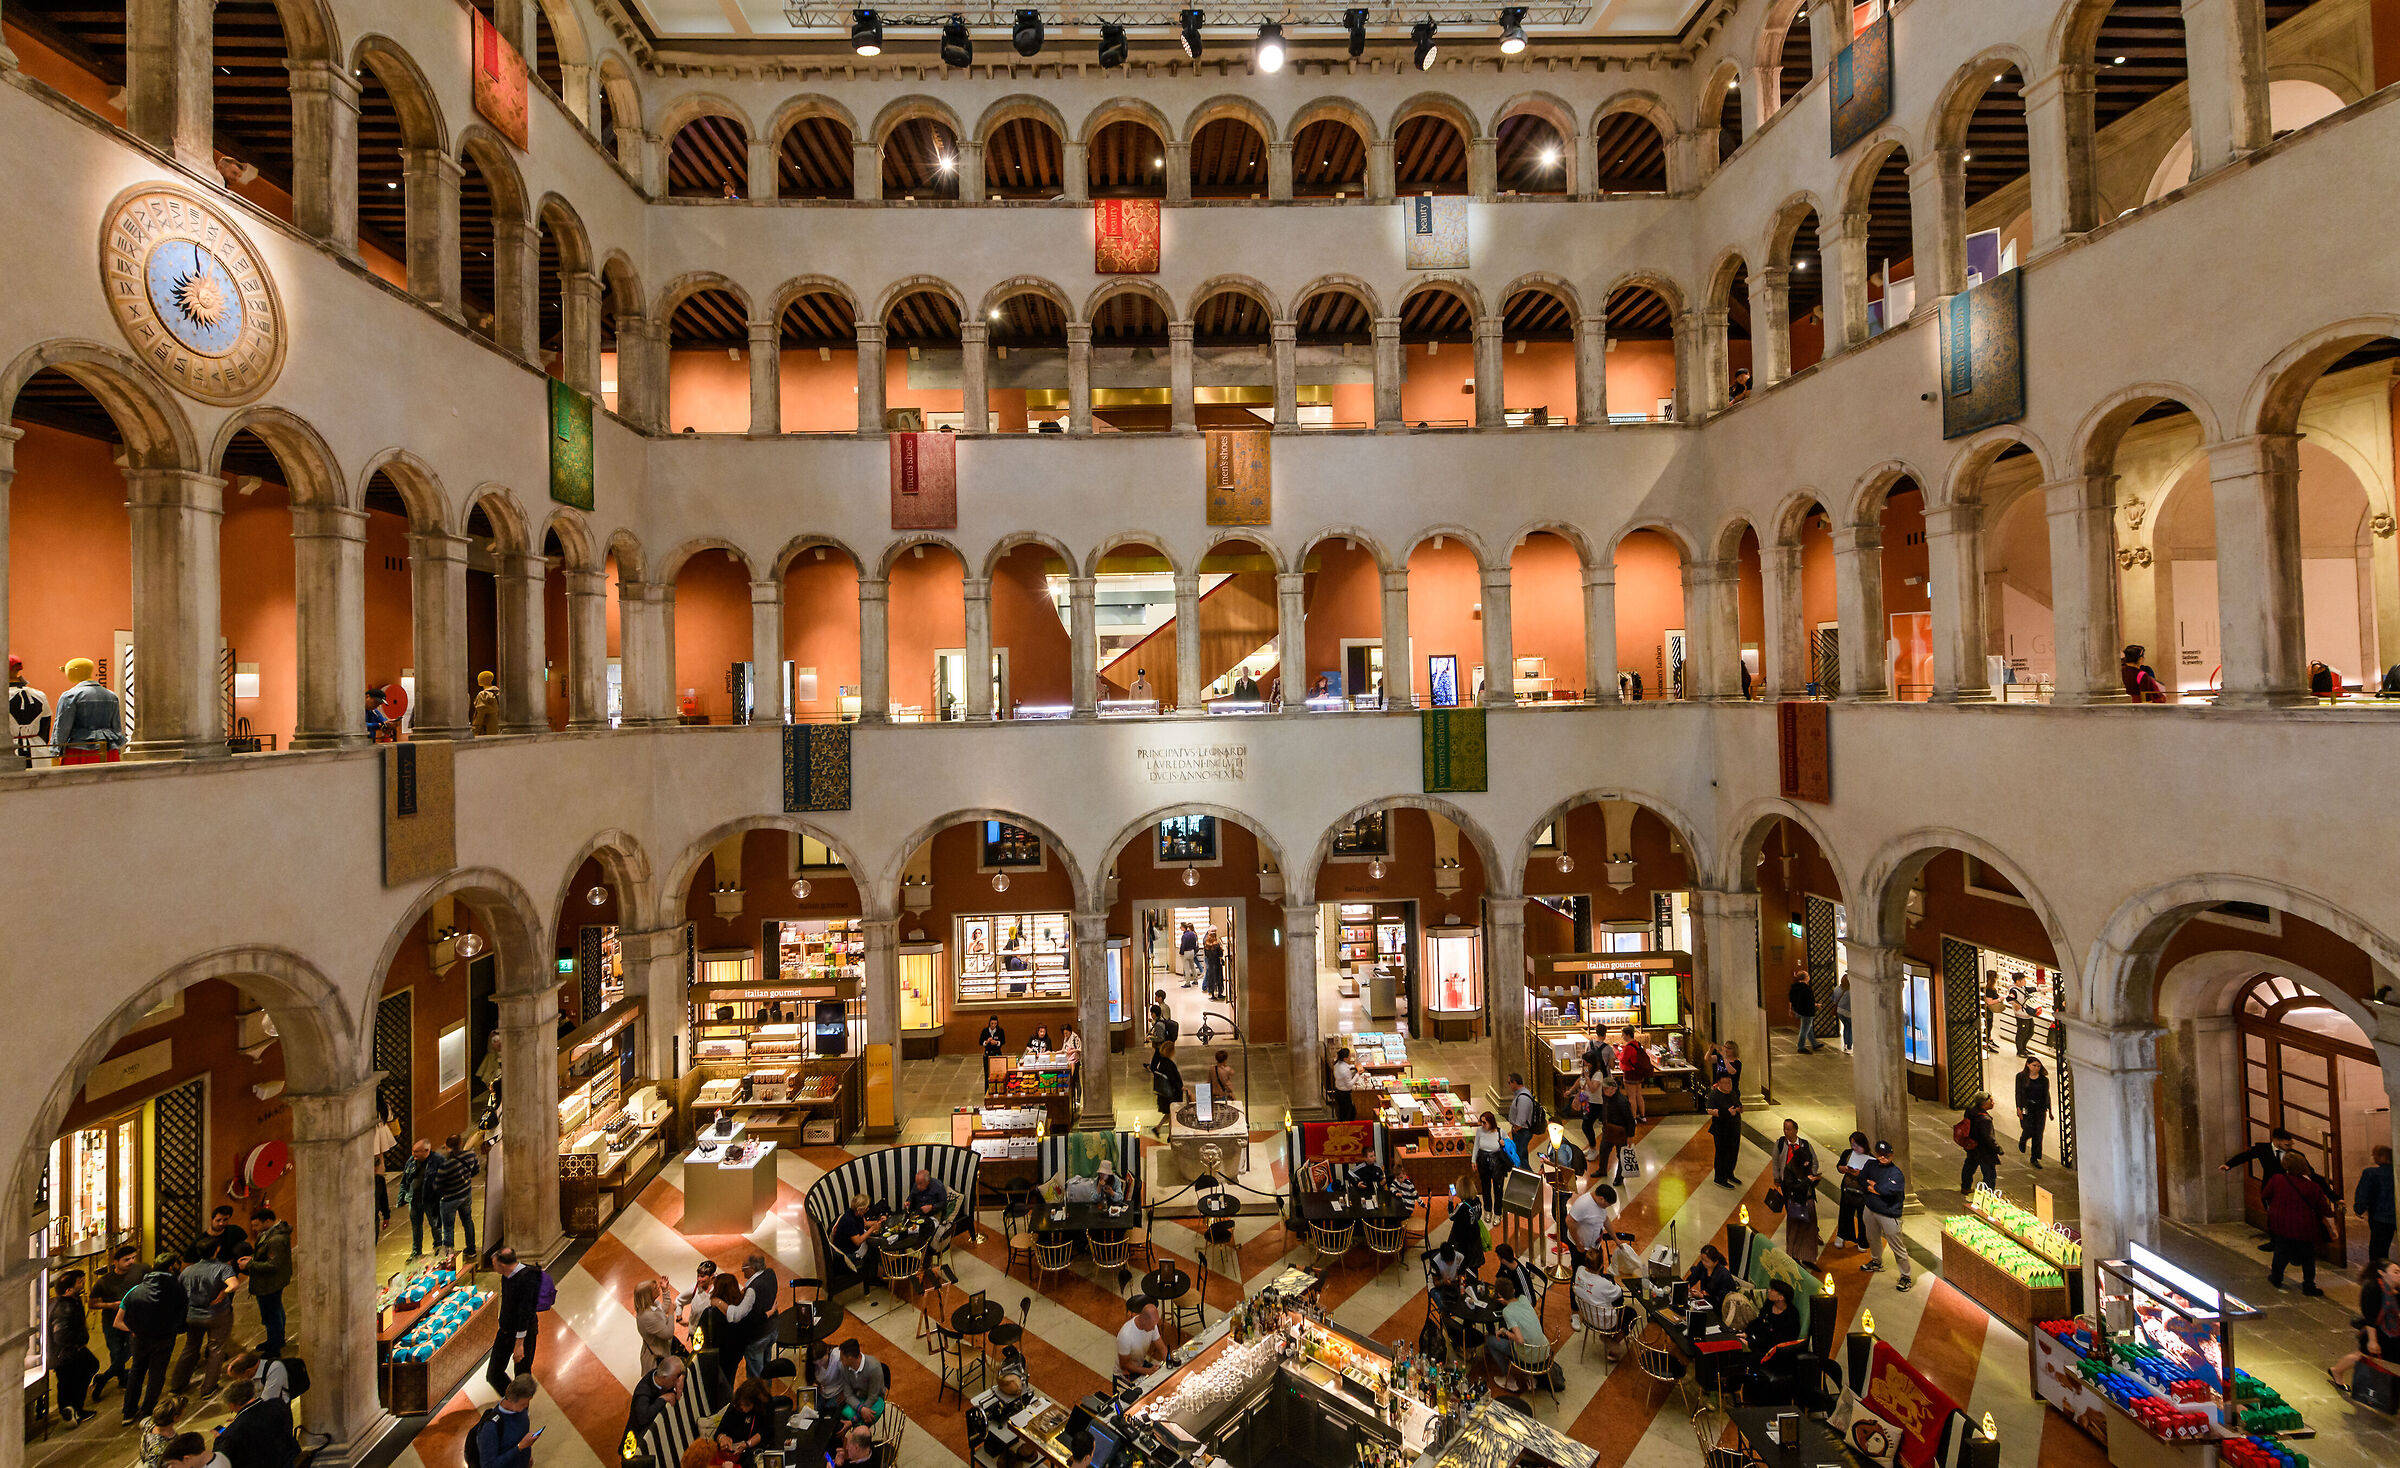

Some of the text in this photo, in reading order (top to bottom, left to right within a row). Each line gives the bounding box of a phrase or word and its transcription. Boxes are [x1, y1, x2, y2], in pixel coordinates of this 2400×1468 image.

[1109, 205, 1119, 236] beauty
[1419, 203, 1429, 233] beauty
[904, 440, 914, 490] men's shoes
[1220, 435, 1229, 485] men's shoes
[1655, 645, 1663, 669] fashion
[1435, 714, 1446, 786] women's fashion
[1587, 961, 1642, 970] italian gourmet
[744, 989, 802, 998] italian gourmet
